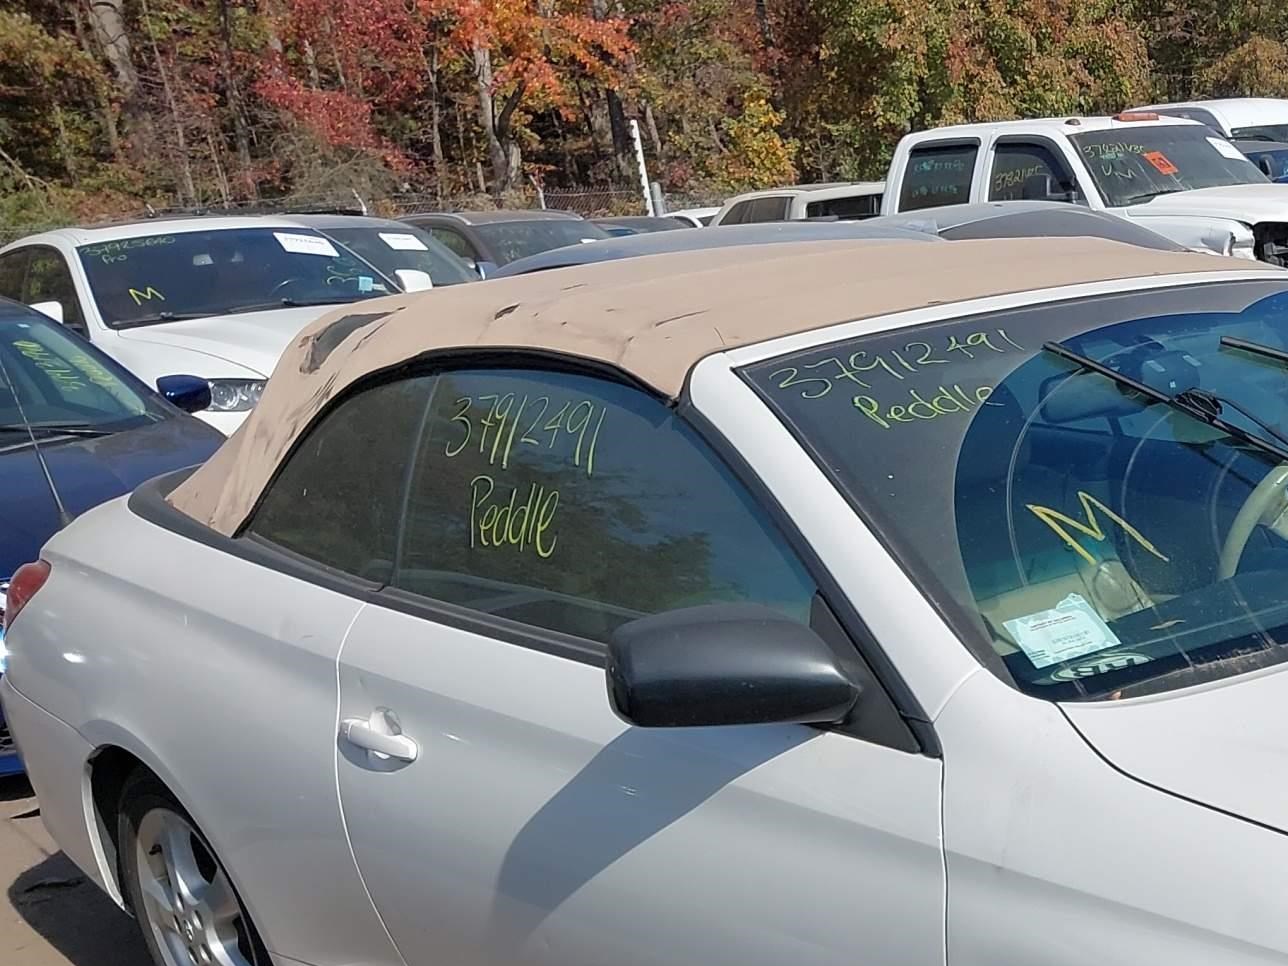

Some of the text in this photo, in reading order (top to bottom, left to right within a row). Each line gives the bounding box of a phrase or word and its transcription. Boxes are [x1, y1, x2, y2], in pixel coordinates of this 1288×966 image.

[127, 286, 166, 307] M
[768, 327, 1026, 400] 37912491
[444, 391, 608, 477] 37912491
[852, 383, 1005, 430] Peddle
[469, 473, 561, 559] Peddle
[1025, 490, 1170, 566] M
